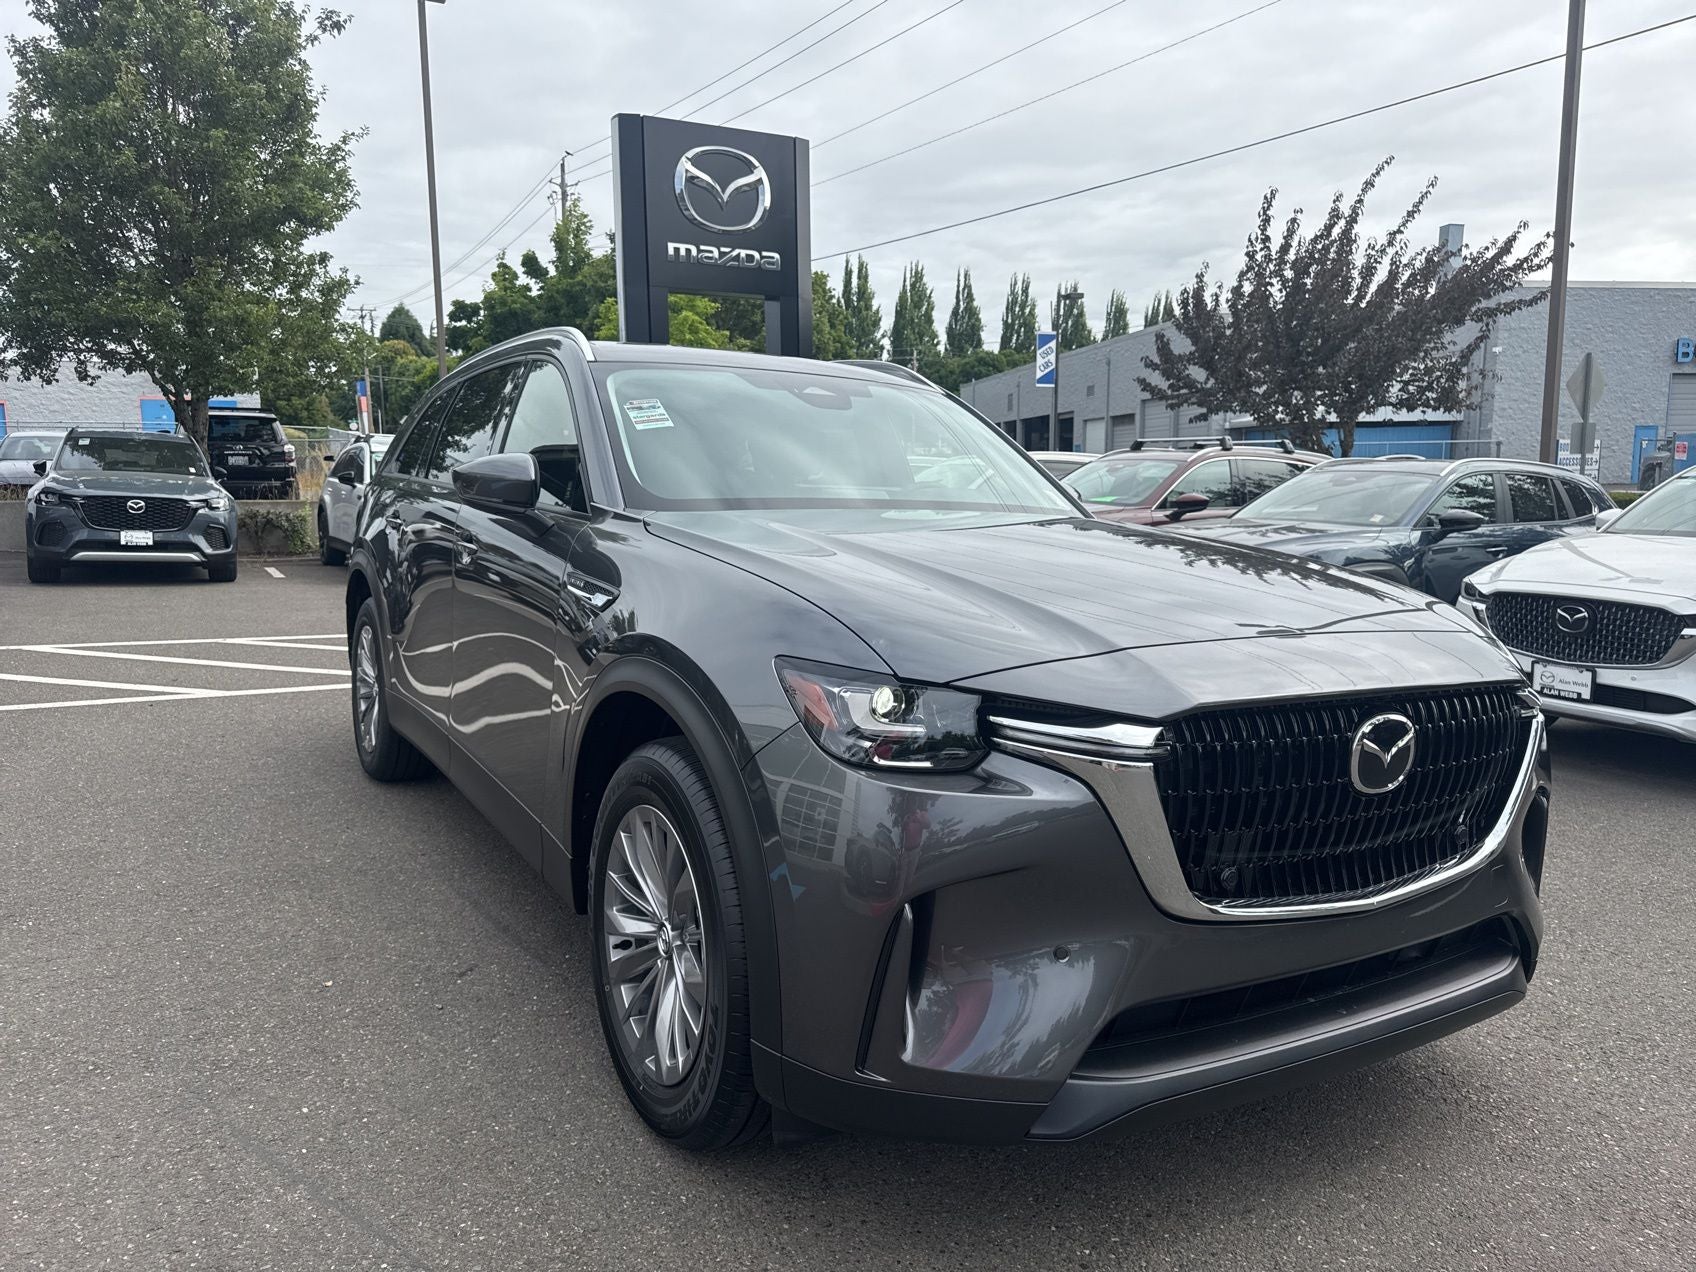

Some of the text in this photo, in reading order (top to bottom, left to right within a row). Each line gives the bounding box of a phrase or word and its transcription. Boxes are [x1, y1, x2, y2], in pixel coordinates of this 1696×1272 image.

[1039, 345, 1054, 359] USED
[1676, 337, 1696, 364] B
[1038, 358, 1053, 372] CARS
[1572, 680, 1588, 688] Webb
[1543, 688, 1577, 699] ALAN WEBB
